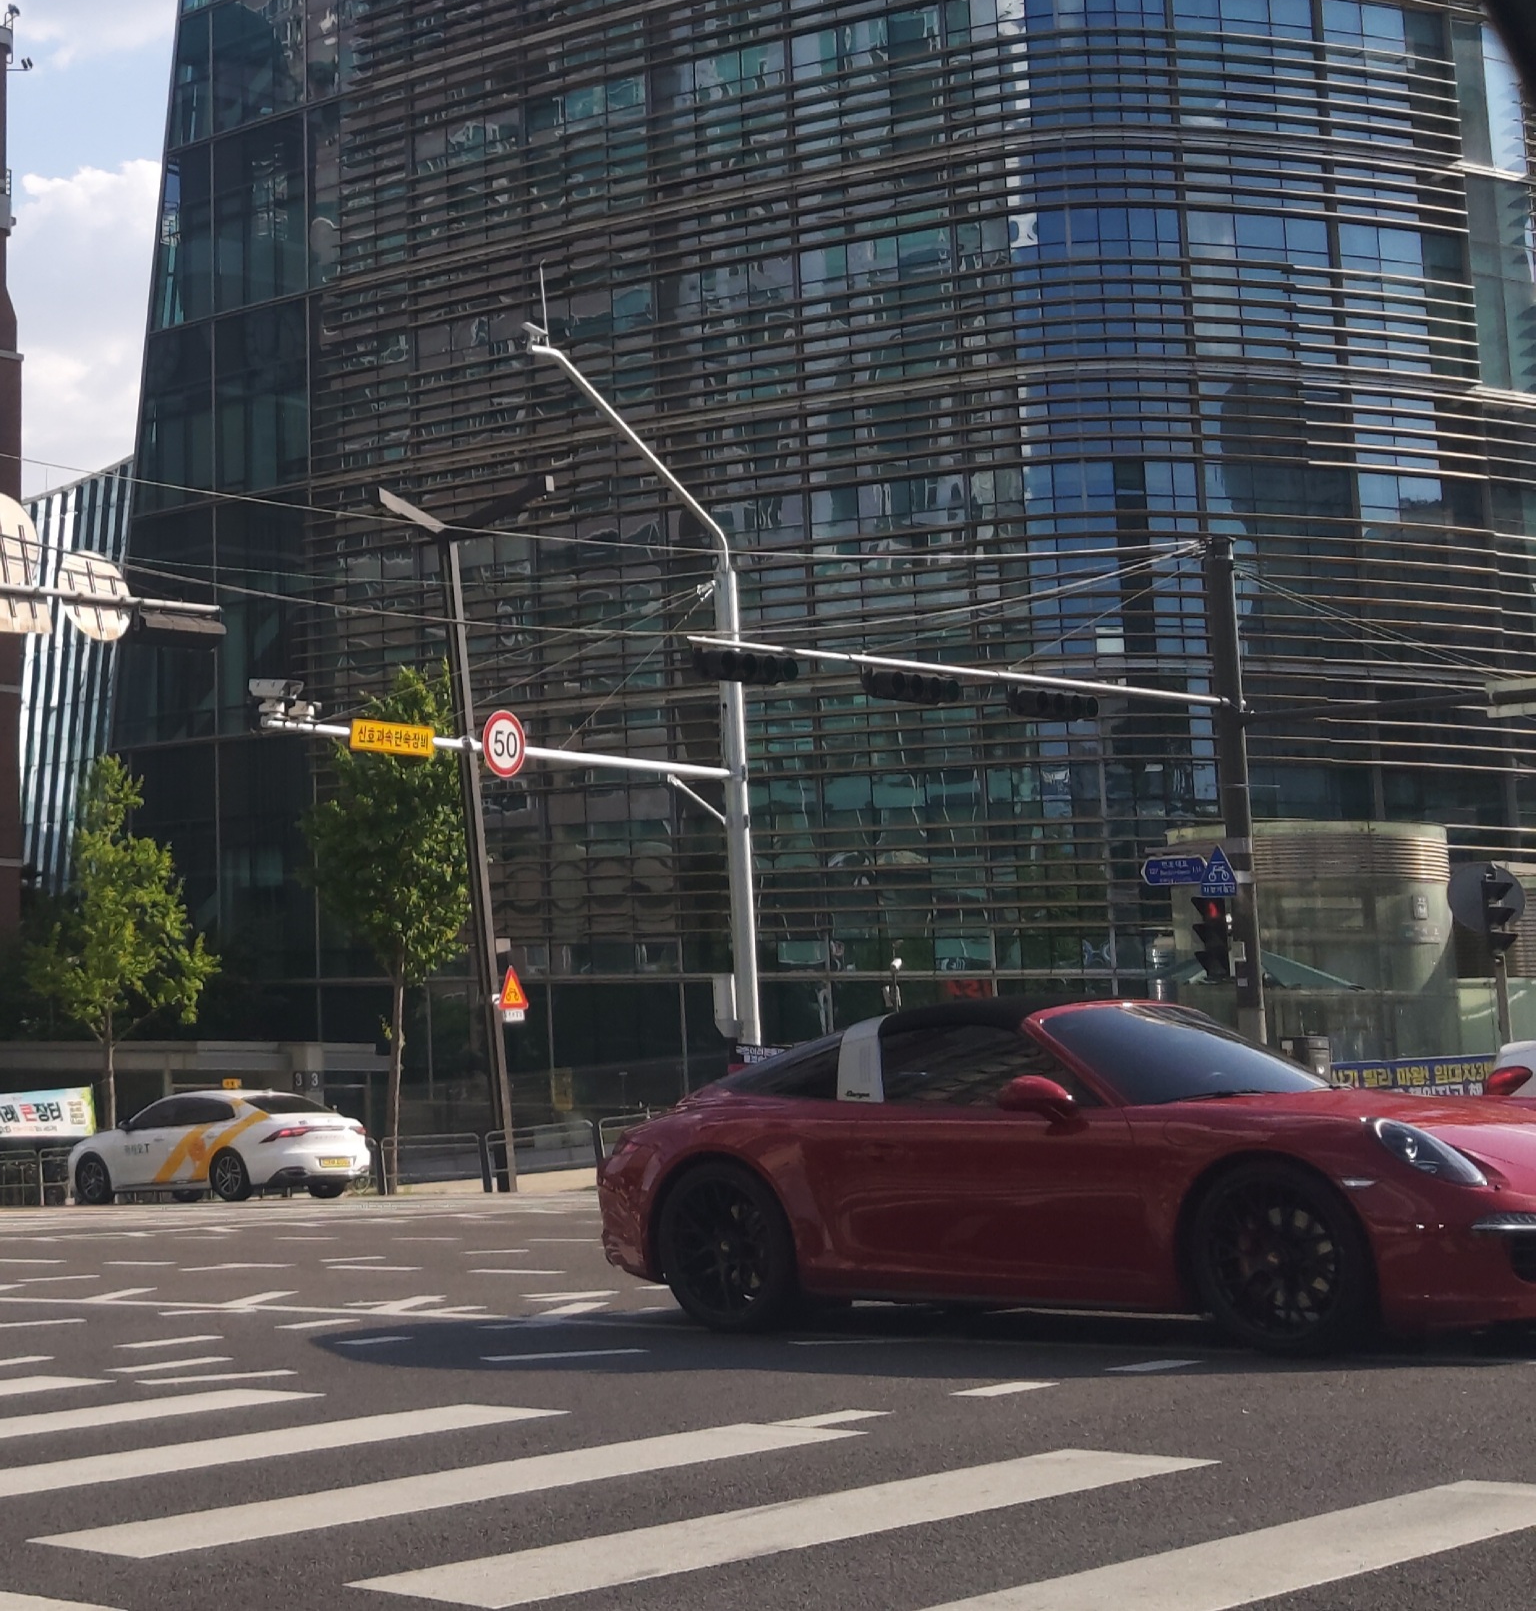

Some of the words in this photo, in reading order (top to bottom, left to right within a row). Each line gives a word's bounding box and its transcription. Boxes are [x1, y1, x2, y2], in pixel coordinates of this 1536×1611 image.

[357, 725, 429, 750] 신호과속단속장비
[493, 730, 517, 758] 50
[311, 1072, 319, 1086] 3
[19, 1101, 64, 1122] 큰장터
